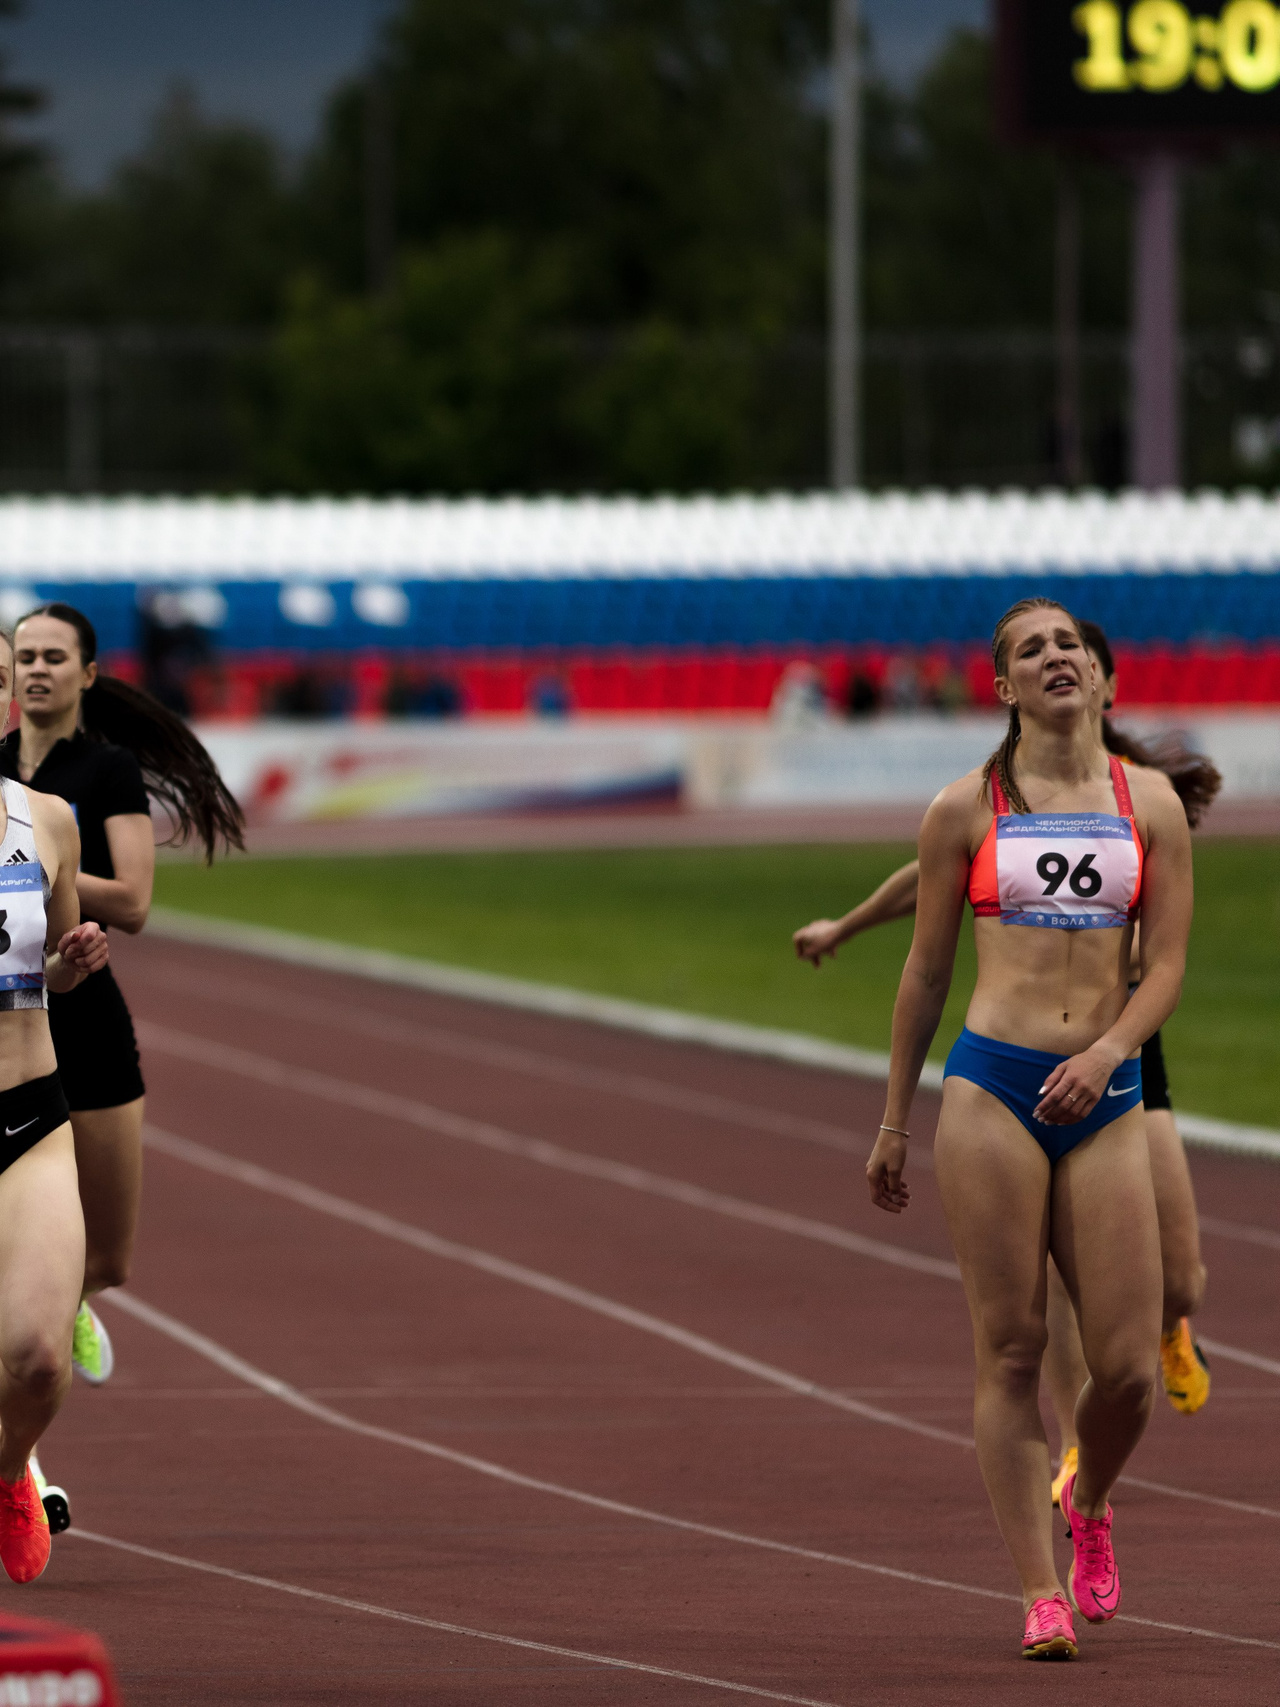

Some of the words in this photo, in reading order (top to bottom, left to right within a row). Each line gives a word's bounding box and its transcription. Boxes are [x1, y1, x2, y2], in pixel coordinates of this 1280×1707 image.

[1006, 825, 1090, 833] ФЕДЕРАЛЬНОГО
[1036, 852, 1102, 898] 96
[1051, 916, 1086, 926] ВФЛА
